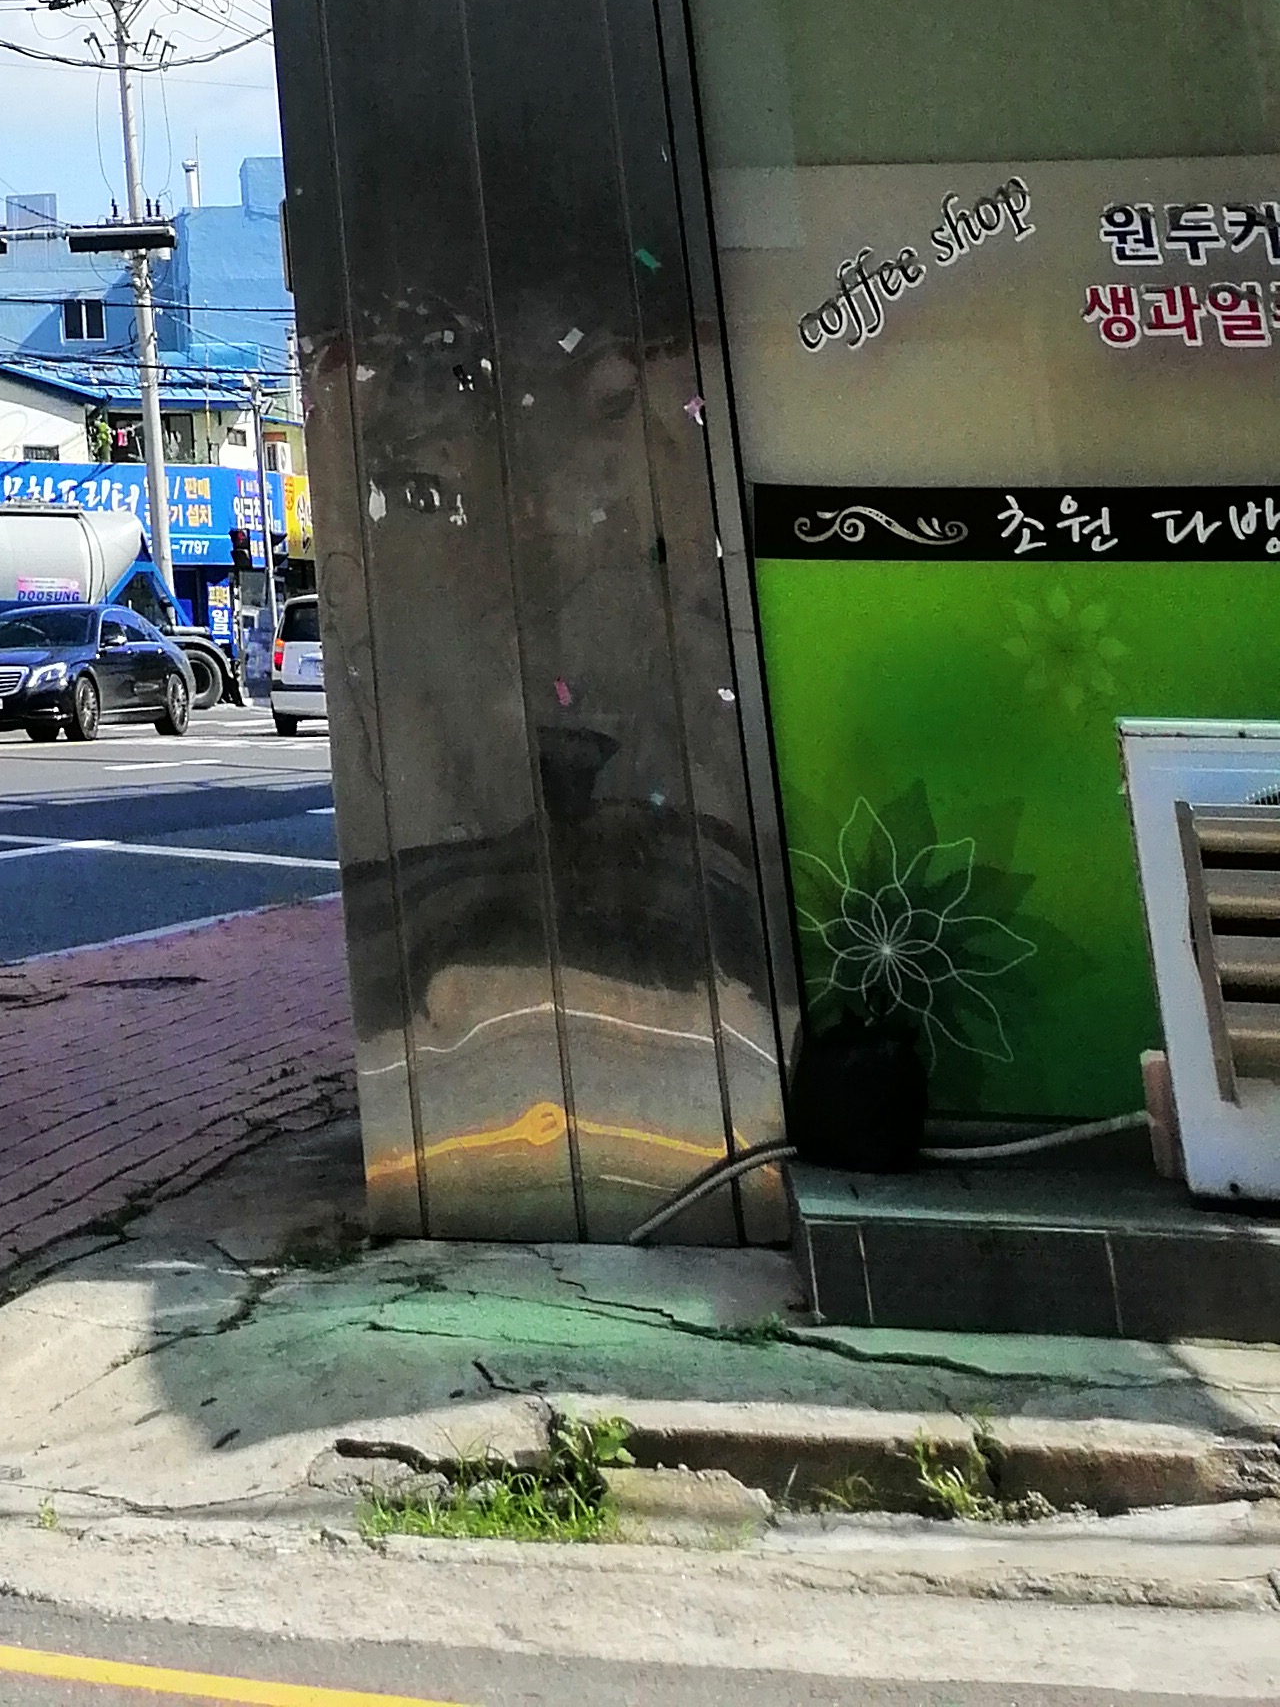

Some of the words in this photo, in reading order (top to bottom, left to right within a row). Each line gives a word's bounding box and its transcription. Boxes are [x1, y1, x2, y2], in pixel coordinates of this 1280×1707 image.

[796, 247, 927, 353] coffee
[928, 175, 1038, 268] shop
[996, 493, 1120, 555] 초원
[1150, 497, 1280, 555] 다방
[17, 590, 81, 602] DOOSUNG
